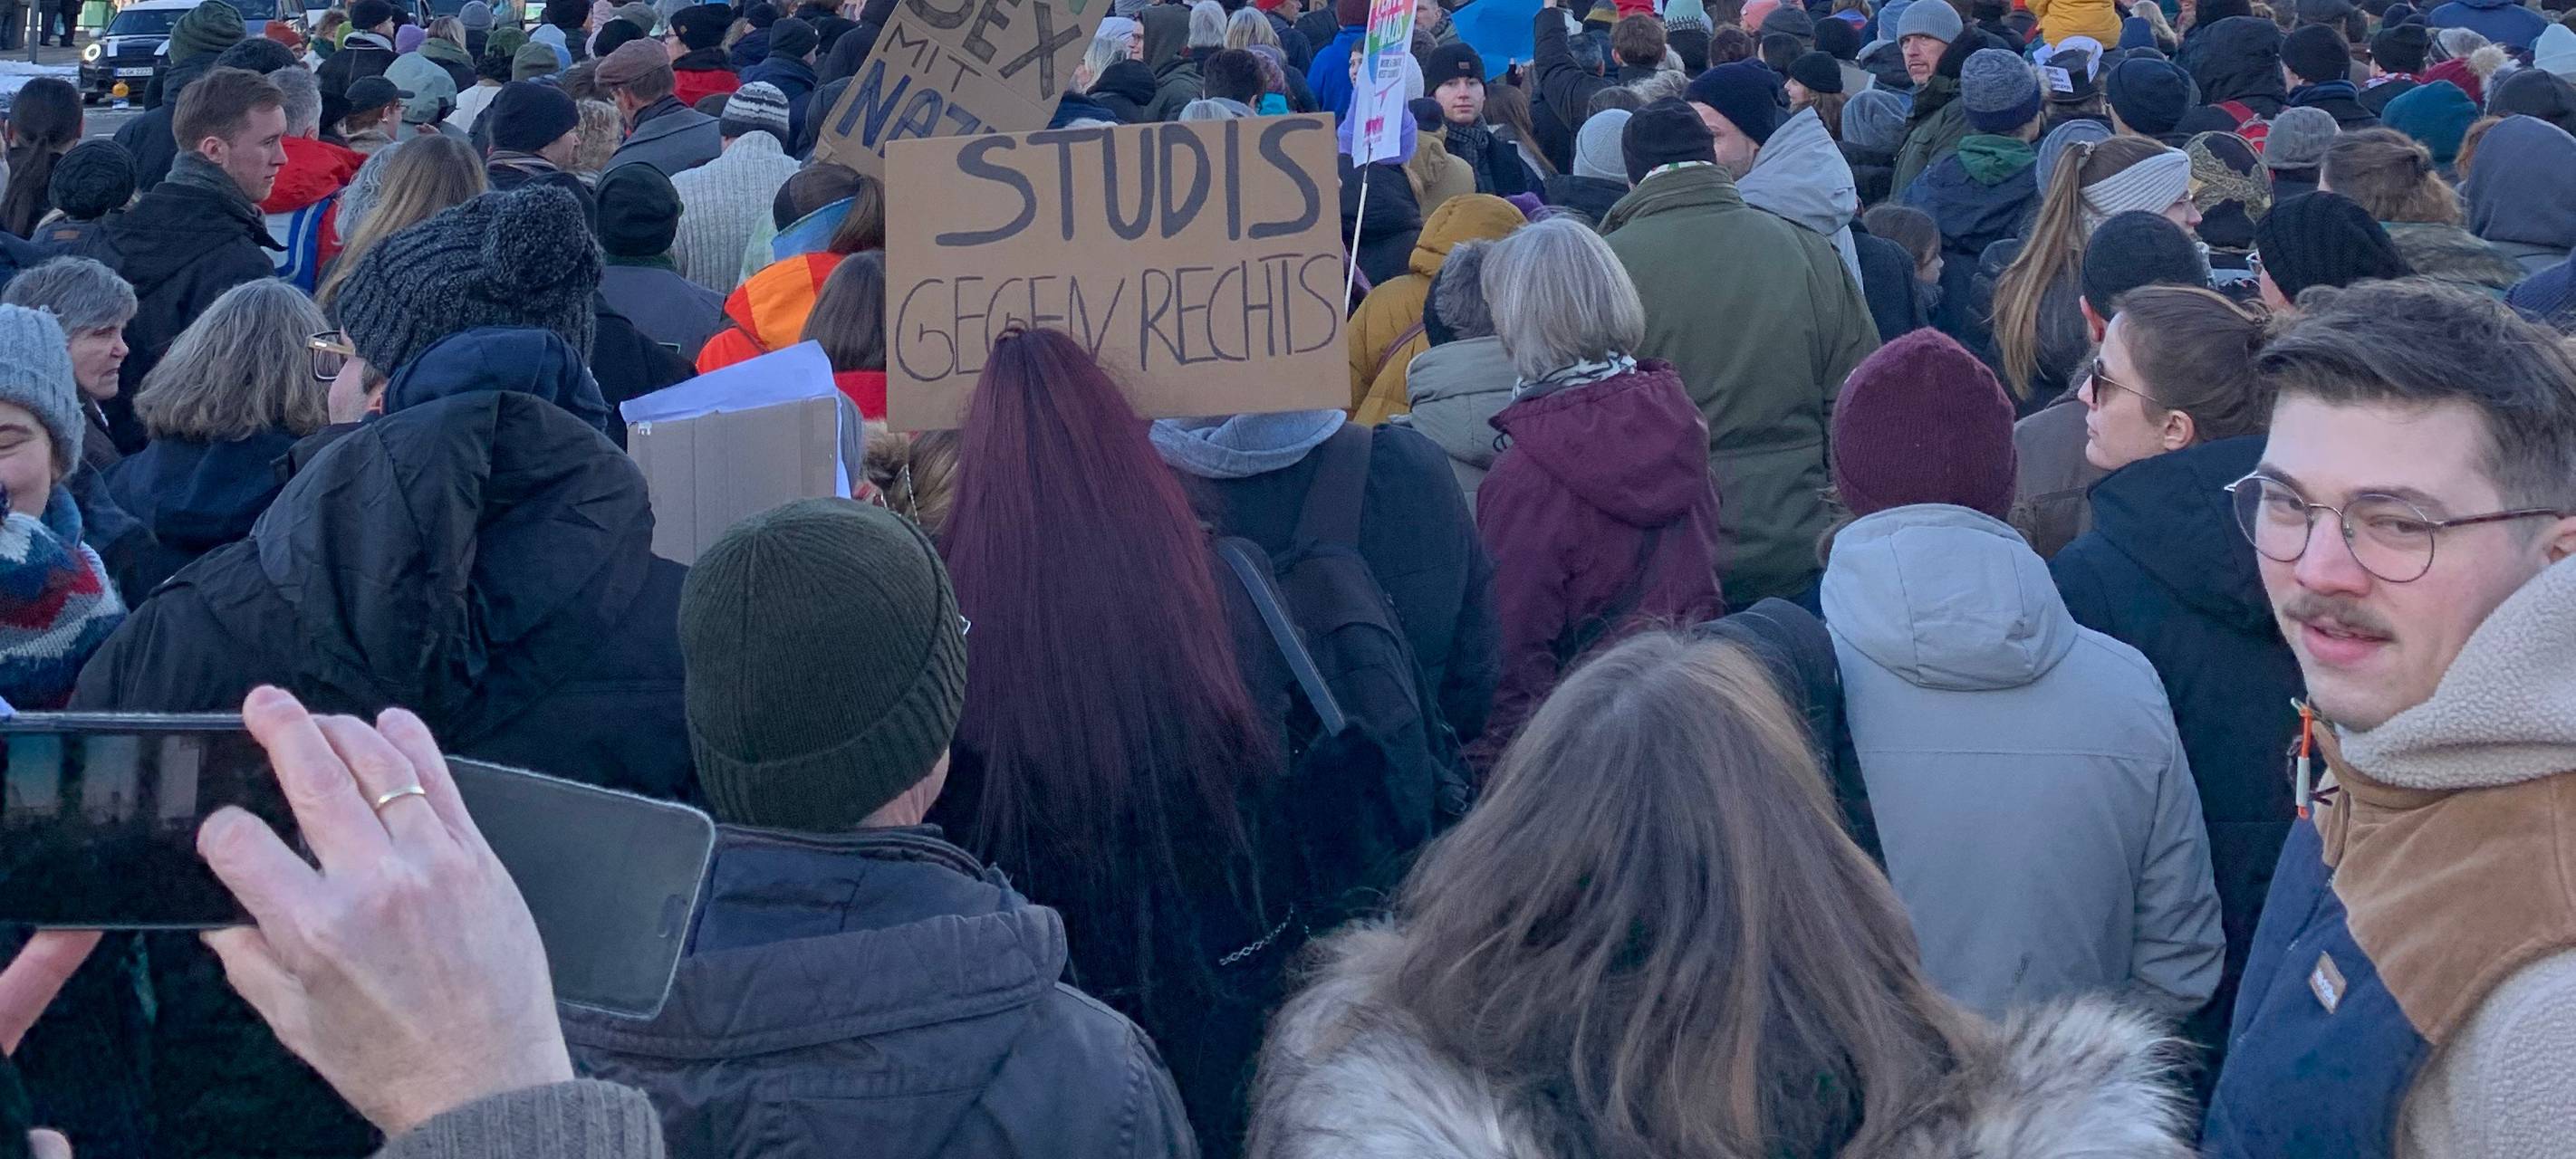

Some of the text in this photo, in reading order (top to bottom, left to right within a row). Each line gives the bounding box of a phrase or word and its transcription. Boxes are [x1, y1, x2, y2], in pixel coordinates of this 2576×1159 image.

[835, 58, 997, 158] NAZ
[883, 21, 982, 92] MIT
[935, 117, 1324, 246] STUDIS
[895, 253, 1338, 382] GEGEN RECHTS
